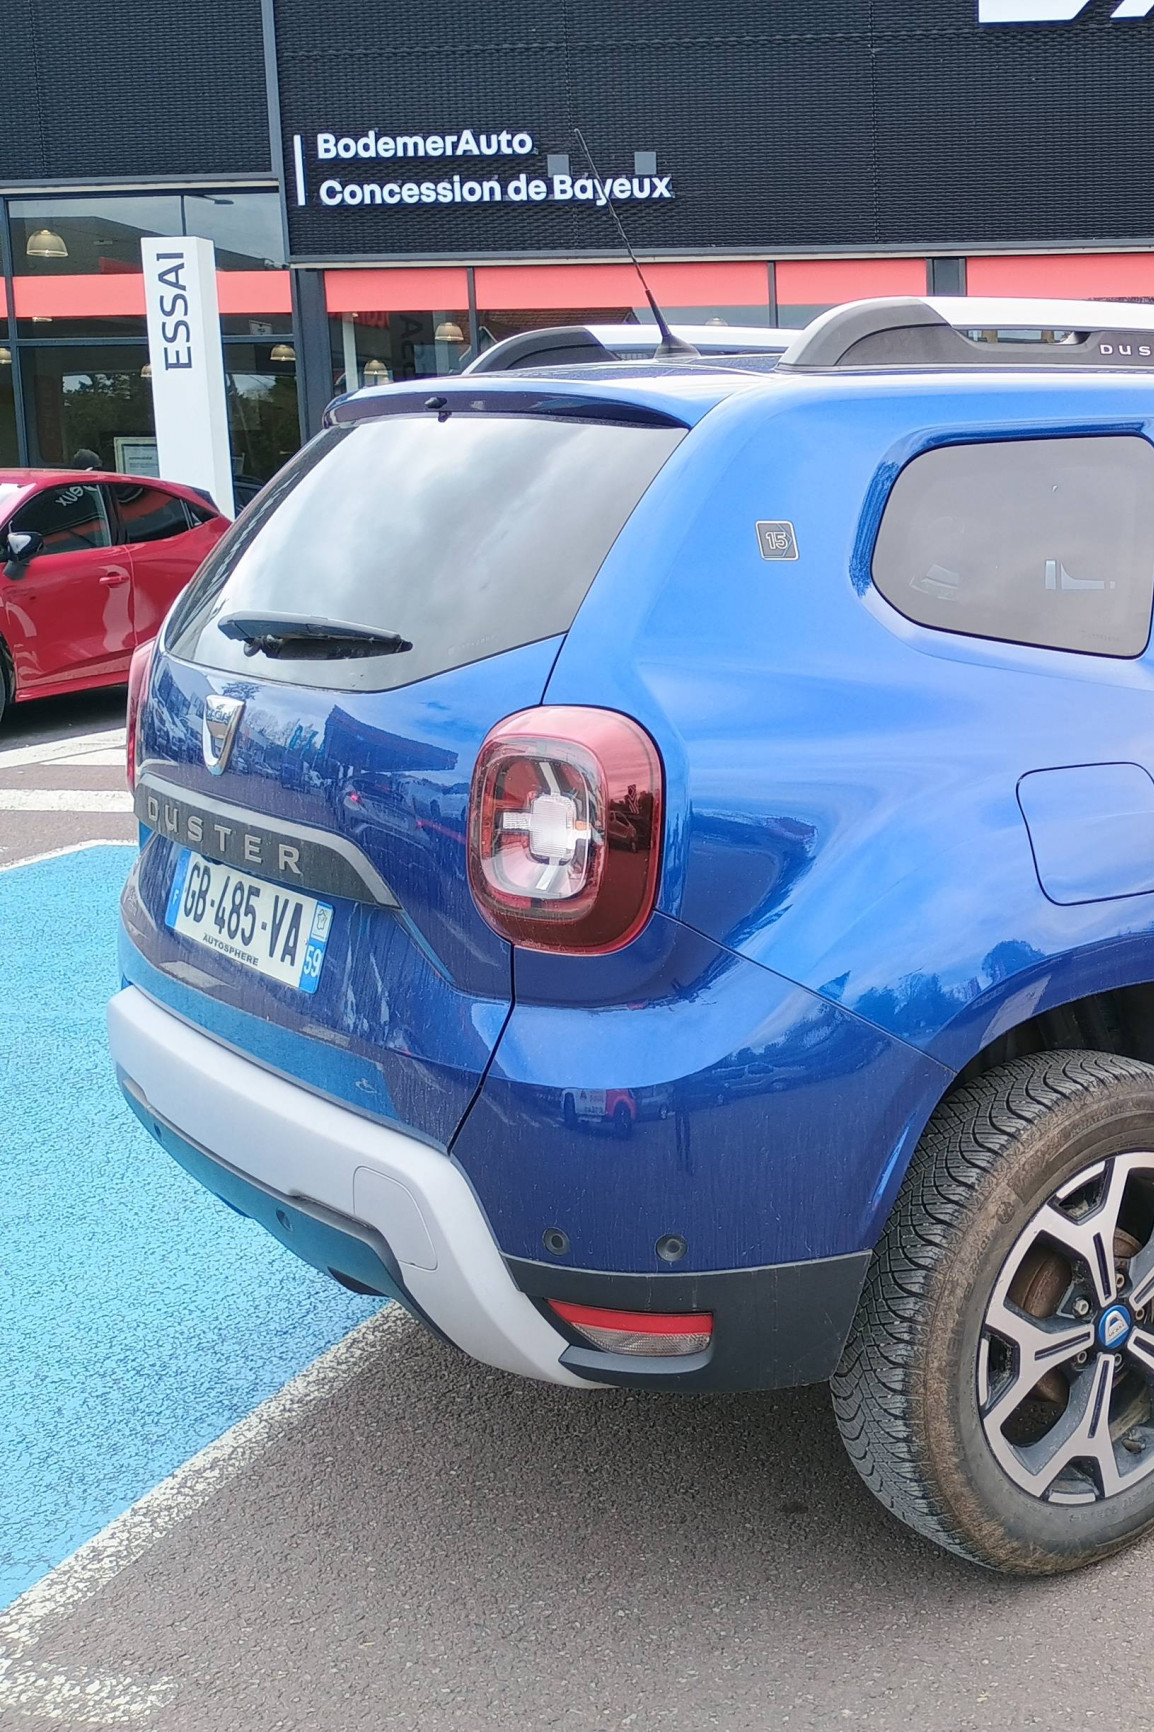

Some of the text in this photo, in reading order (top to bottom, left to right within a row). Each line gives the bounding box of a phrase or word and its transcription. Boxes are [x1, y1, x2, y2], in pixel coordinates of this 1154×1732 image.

[317, 129, 533, 159] BodemerAuto
[320, 174, 672, 206] Concession de Bayeux
[156, 252, 193, 371] ESSAI
[765, 531, 789, 550] 15
[147, 796, 302, 875] DUSTER
[172, 861, 322, 978] F GB-485-VA 59
[202, 932, 260, 967] AUTOSPHERE
